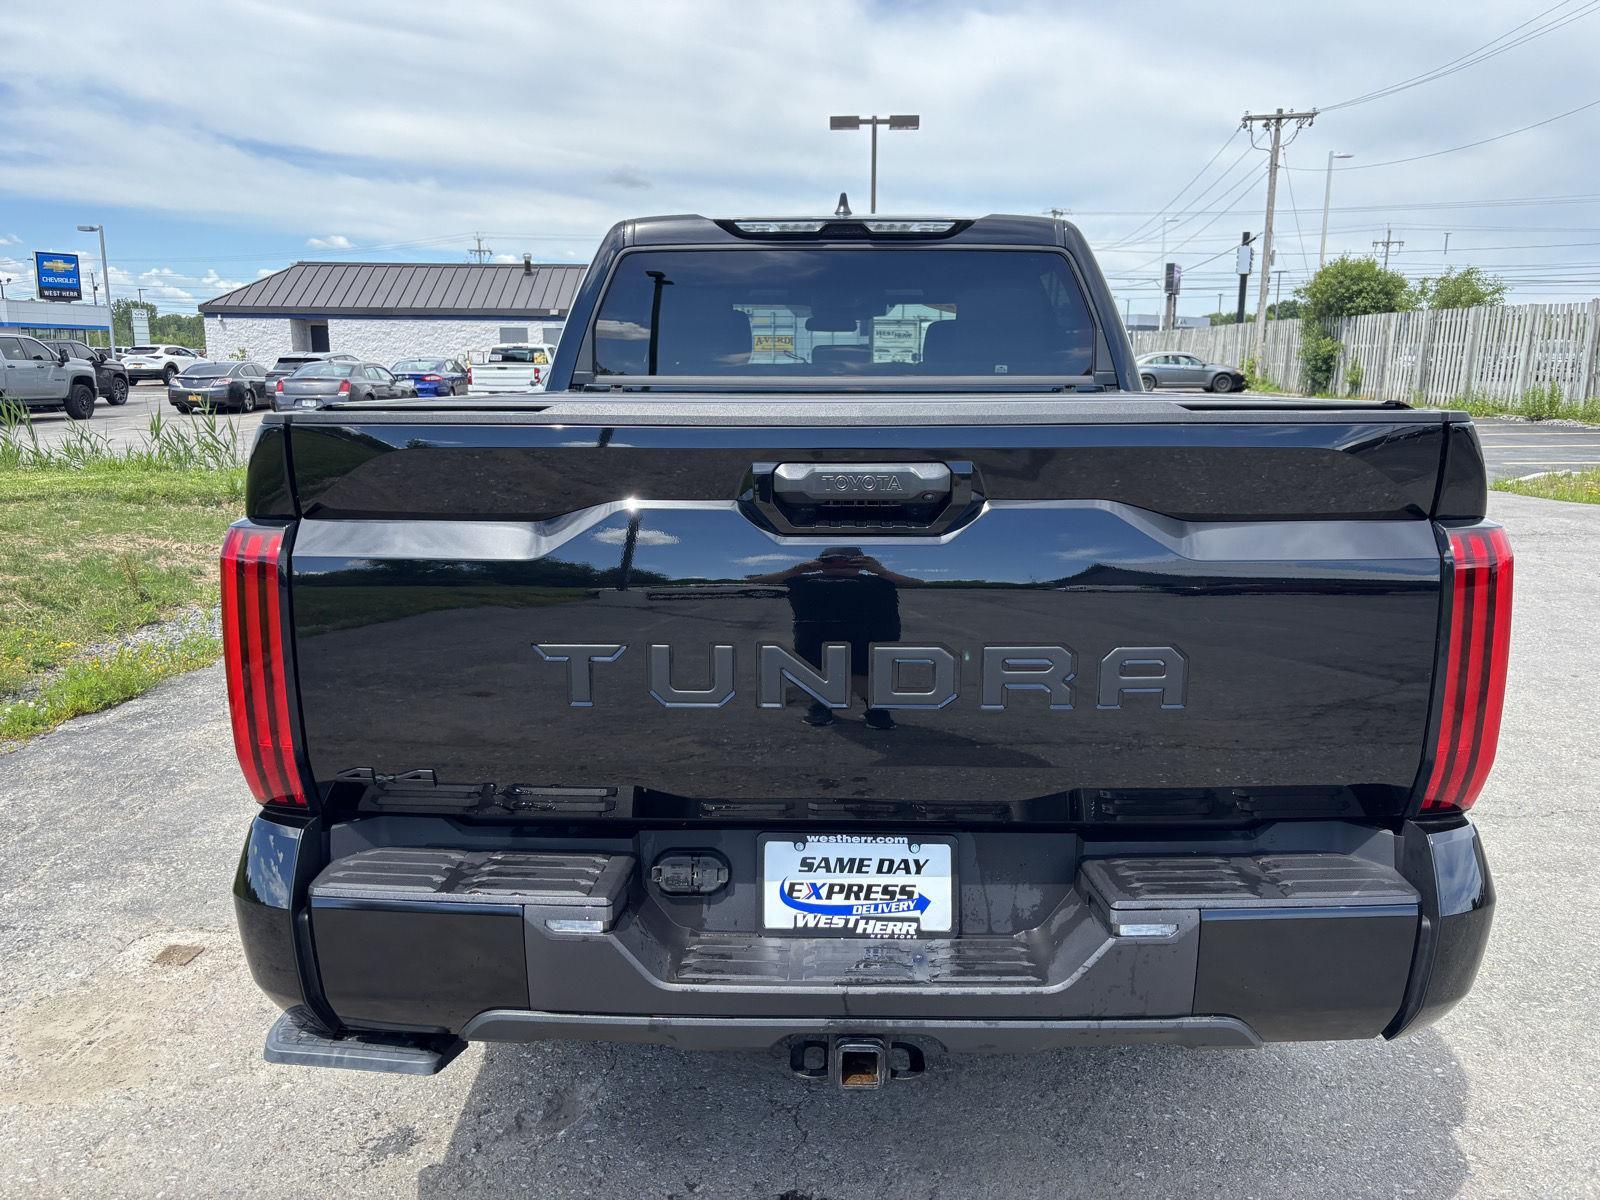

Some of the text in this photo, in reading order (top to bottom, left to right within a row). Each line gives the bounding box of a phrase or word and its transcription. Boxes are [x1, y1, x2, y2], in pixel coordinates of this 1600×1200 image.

[42, 276, 77, 284] CHEVROLET
[755, 336, 794, 346] A-VRDI
[822, 475, 902, 491] TOYOTA
[531, 642, 1189, 710] TUNDRA
[806, 834, 908, 845] westherr.com
[798, 856, 930, 875] SAME DAY
[786, 882, 917, 901] EXPRESS
[852, 900, 917, 915] DELIVERY
